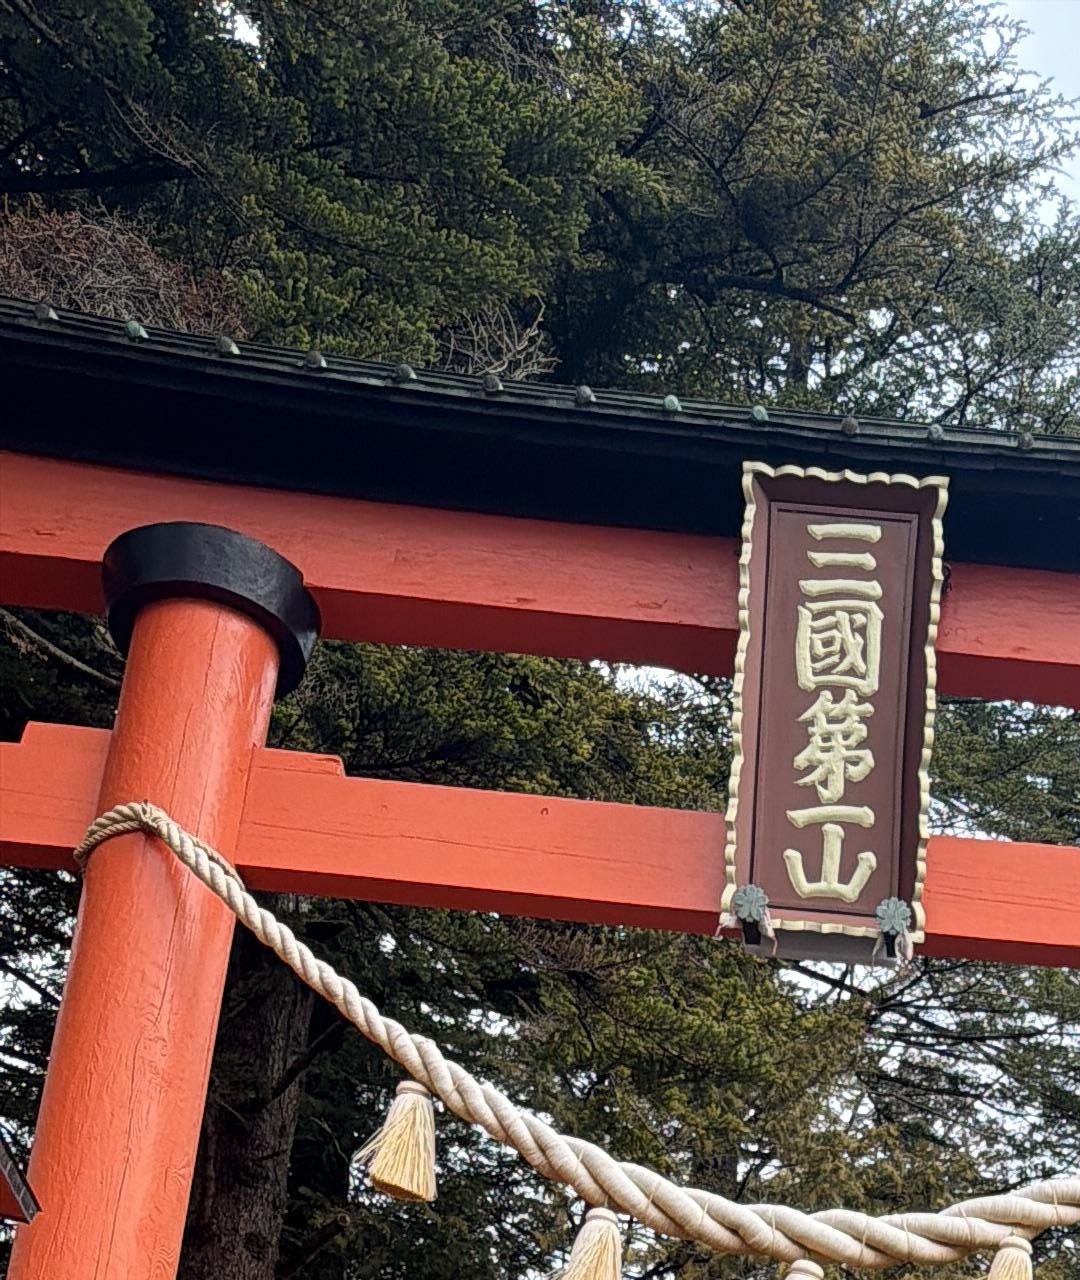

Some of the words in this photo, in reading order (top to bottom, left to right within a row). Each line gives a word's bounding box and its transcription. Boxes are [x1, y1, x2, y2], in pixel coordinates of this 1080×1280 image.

[783, 522, 885, 903] 三國第一山
